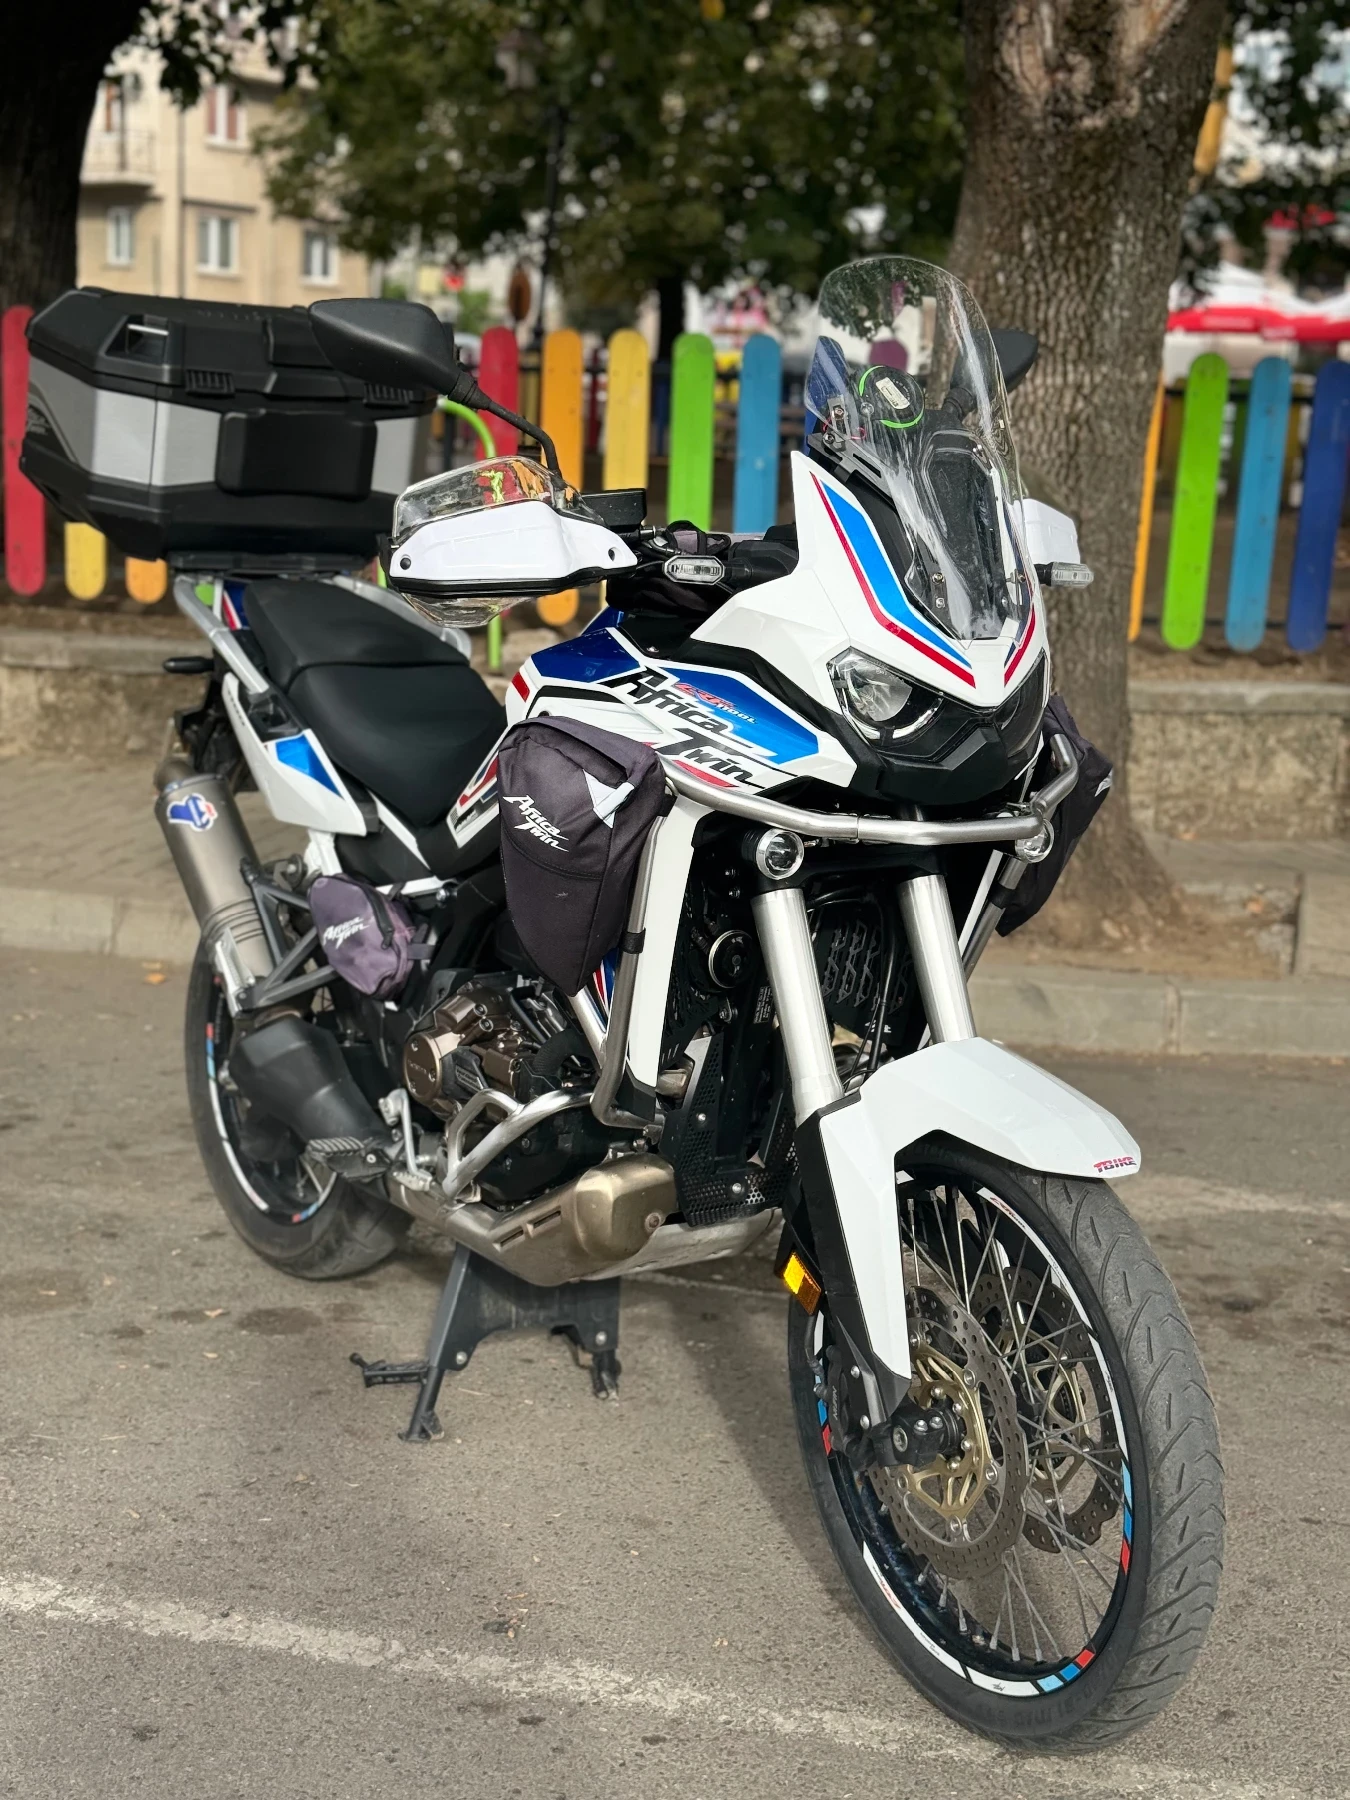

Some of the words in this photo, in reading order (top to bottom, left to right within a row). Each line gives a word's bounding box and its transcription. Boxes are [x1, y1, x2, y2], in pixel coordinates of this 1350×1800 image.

[597, 666, 753, 748] Africa
[654, 727, 798, 789] Twin
[502, 794, 569, 840] Africa
[513, 815, 569, 852] Twin
